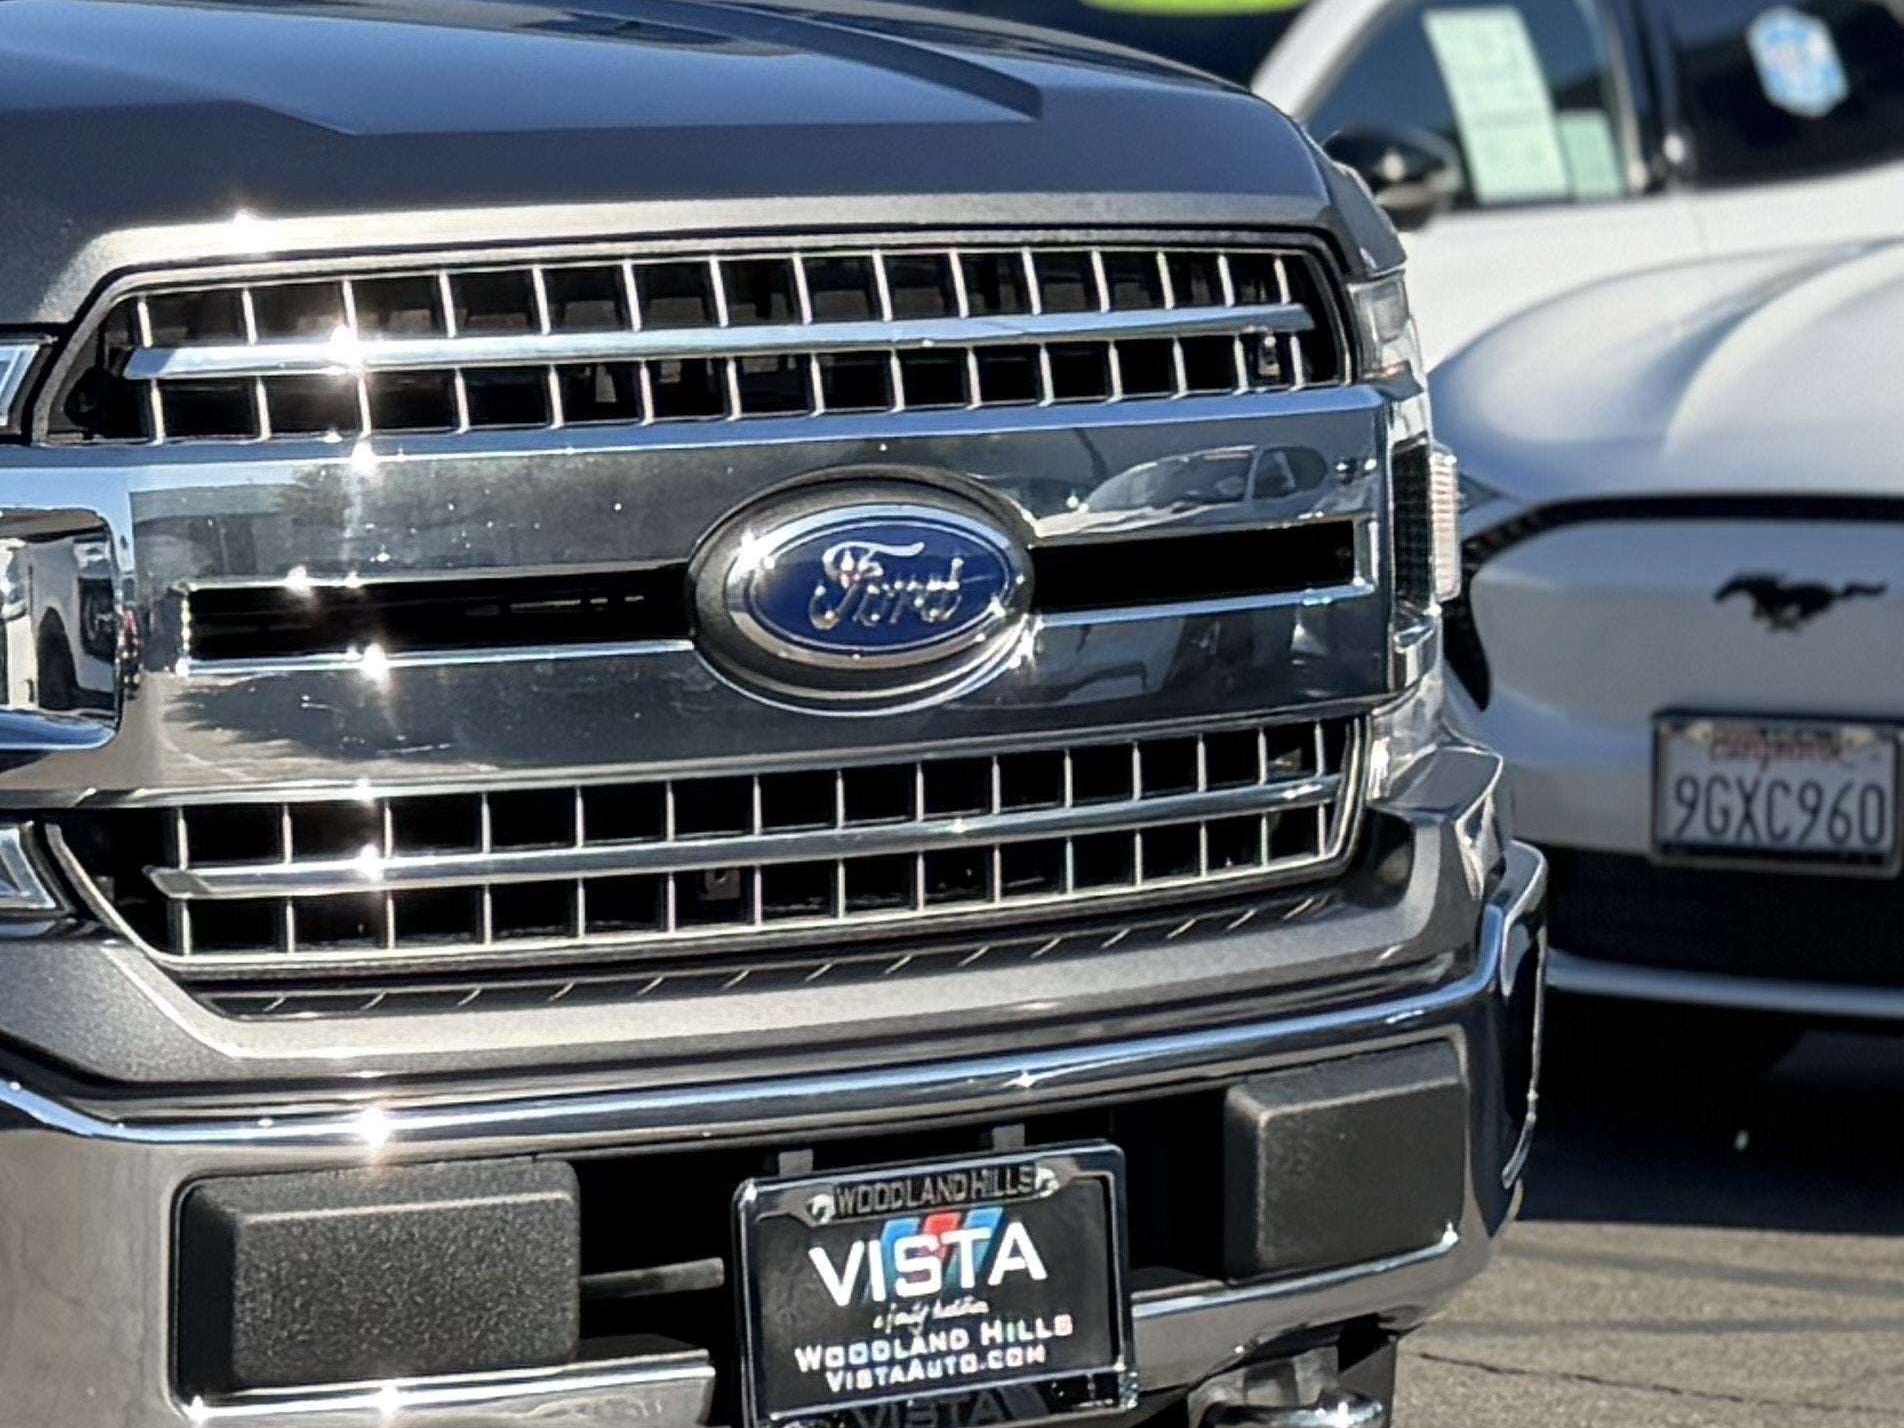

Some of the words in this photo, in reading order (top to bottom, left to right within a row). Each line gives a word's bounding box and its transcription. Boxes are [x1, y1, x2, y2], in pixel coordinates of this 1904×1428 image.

[808, 540, 963, 632] Ford
[1674, 774, 1886, 847] 9GXC960
[835, 1179, 968, 1217] WOODLAND
[968, 1165, 1034, 1200] HILLS
[808, 1220, 1048, 1308] VISTA
[794, 1326, 971, 1373] WOODLAND
[979, 1312, 1074, 1346] HILLS
